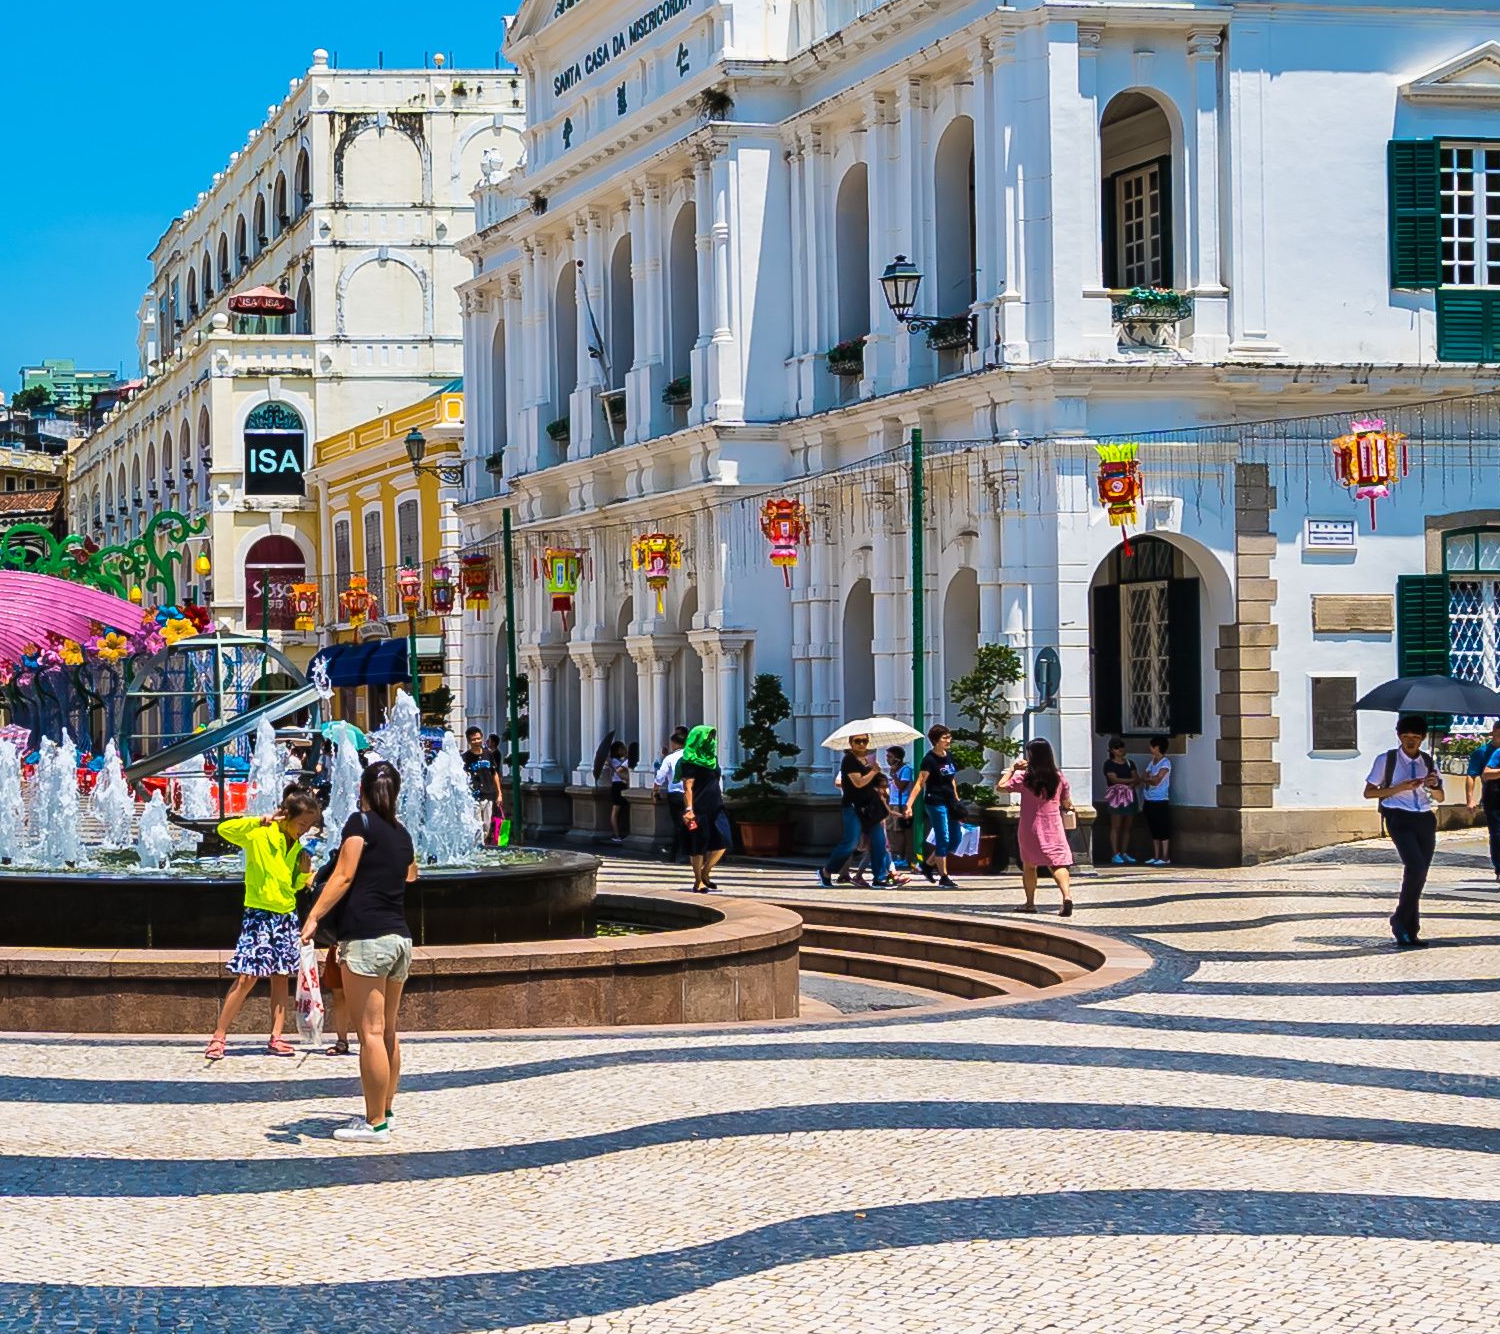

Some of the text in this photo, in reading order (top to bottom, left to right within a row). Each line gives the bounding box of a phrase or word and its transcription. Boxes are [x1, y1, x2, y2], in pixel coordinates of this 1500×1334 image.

[553, 62, 582, 98] SANTA
[584, 43, 610, 75] CASA
[612, 32, 626, 58] DA
[250, 448, 301, 474] ISA
